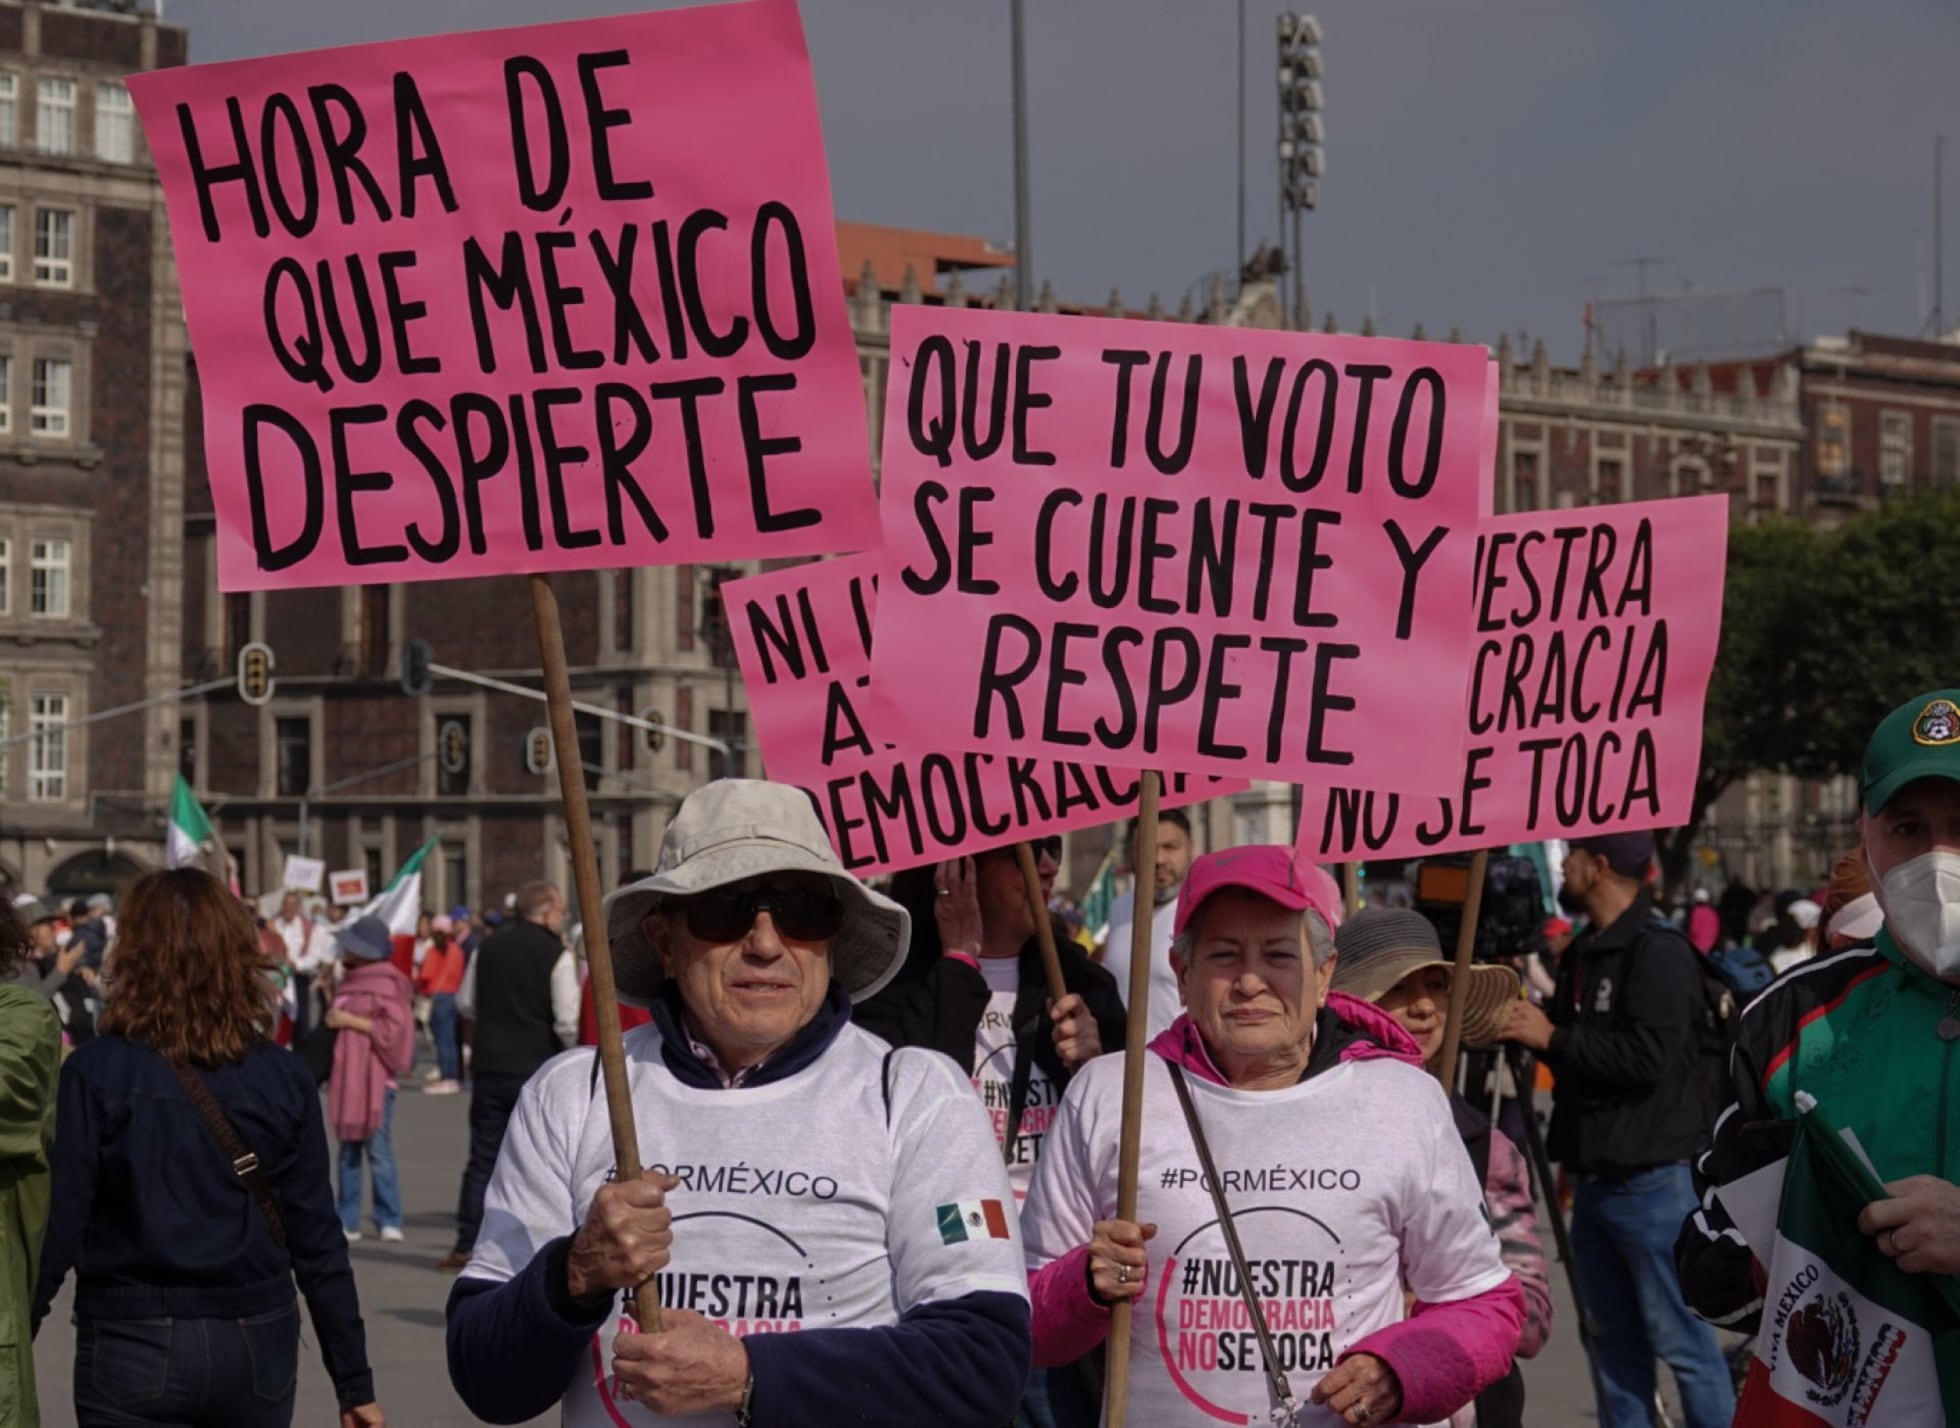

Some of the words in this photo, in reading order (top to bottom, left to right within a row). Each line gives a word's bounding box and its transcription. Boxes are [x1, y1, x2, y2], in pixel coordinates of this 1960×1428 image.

[176, 71, 459, 243] HORA
[504, 49, 655, 212] DE
[263, 250, 441, 393] QUE
[463, 201, 816, 374] MÉXICO
[242, 373, 822, 571] DESPIERTE
[907, 335, 1061, 468] QUE
[1102, 350, 1202, 475] TU
[1233, 354, 1446, 499] VOTO
[746, 587, 829, 684] NI
[901, 481, 999, 595] SE
[1035, 488, 1341, 627] CUENTE
[1383, 518, 1450, 640] Y
[974, 614, 1360, 765] RESPETE
[1519, 729, 1661, 830] TOCA
[1179, 1298, 1337, 1331] DEMORACIA
